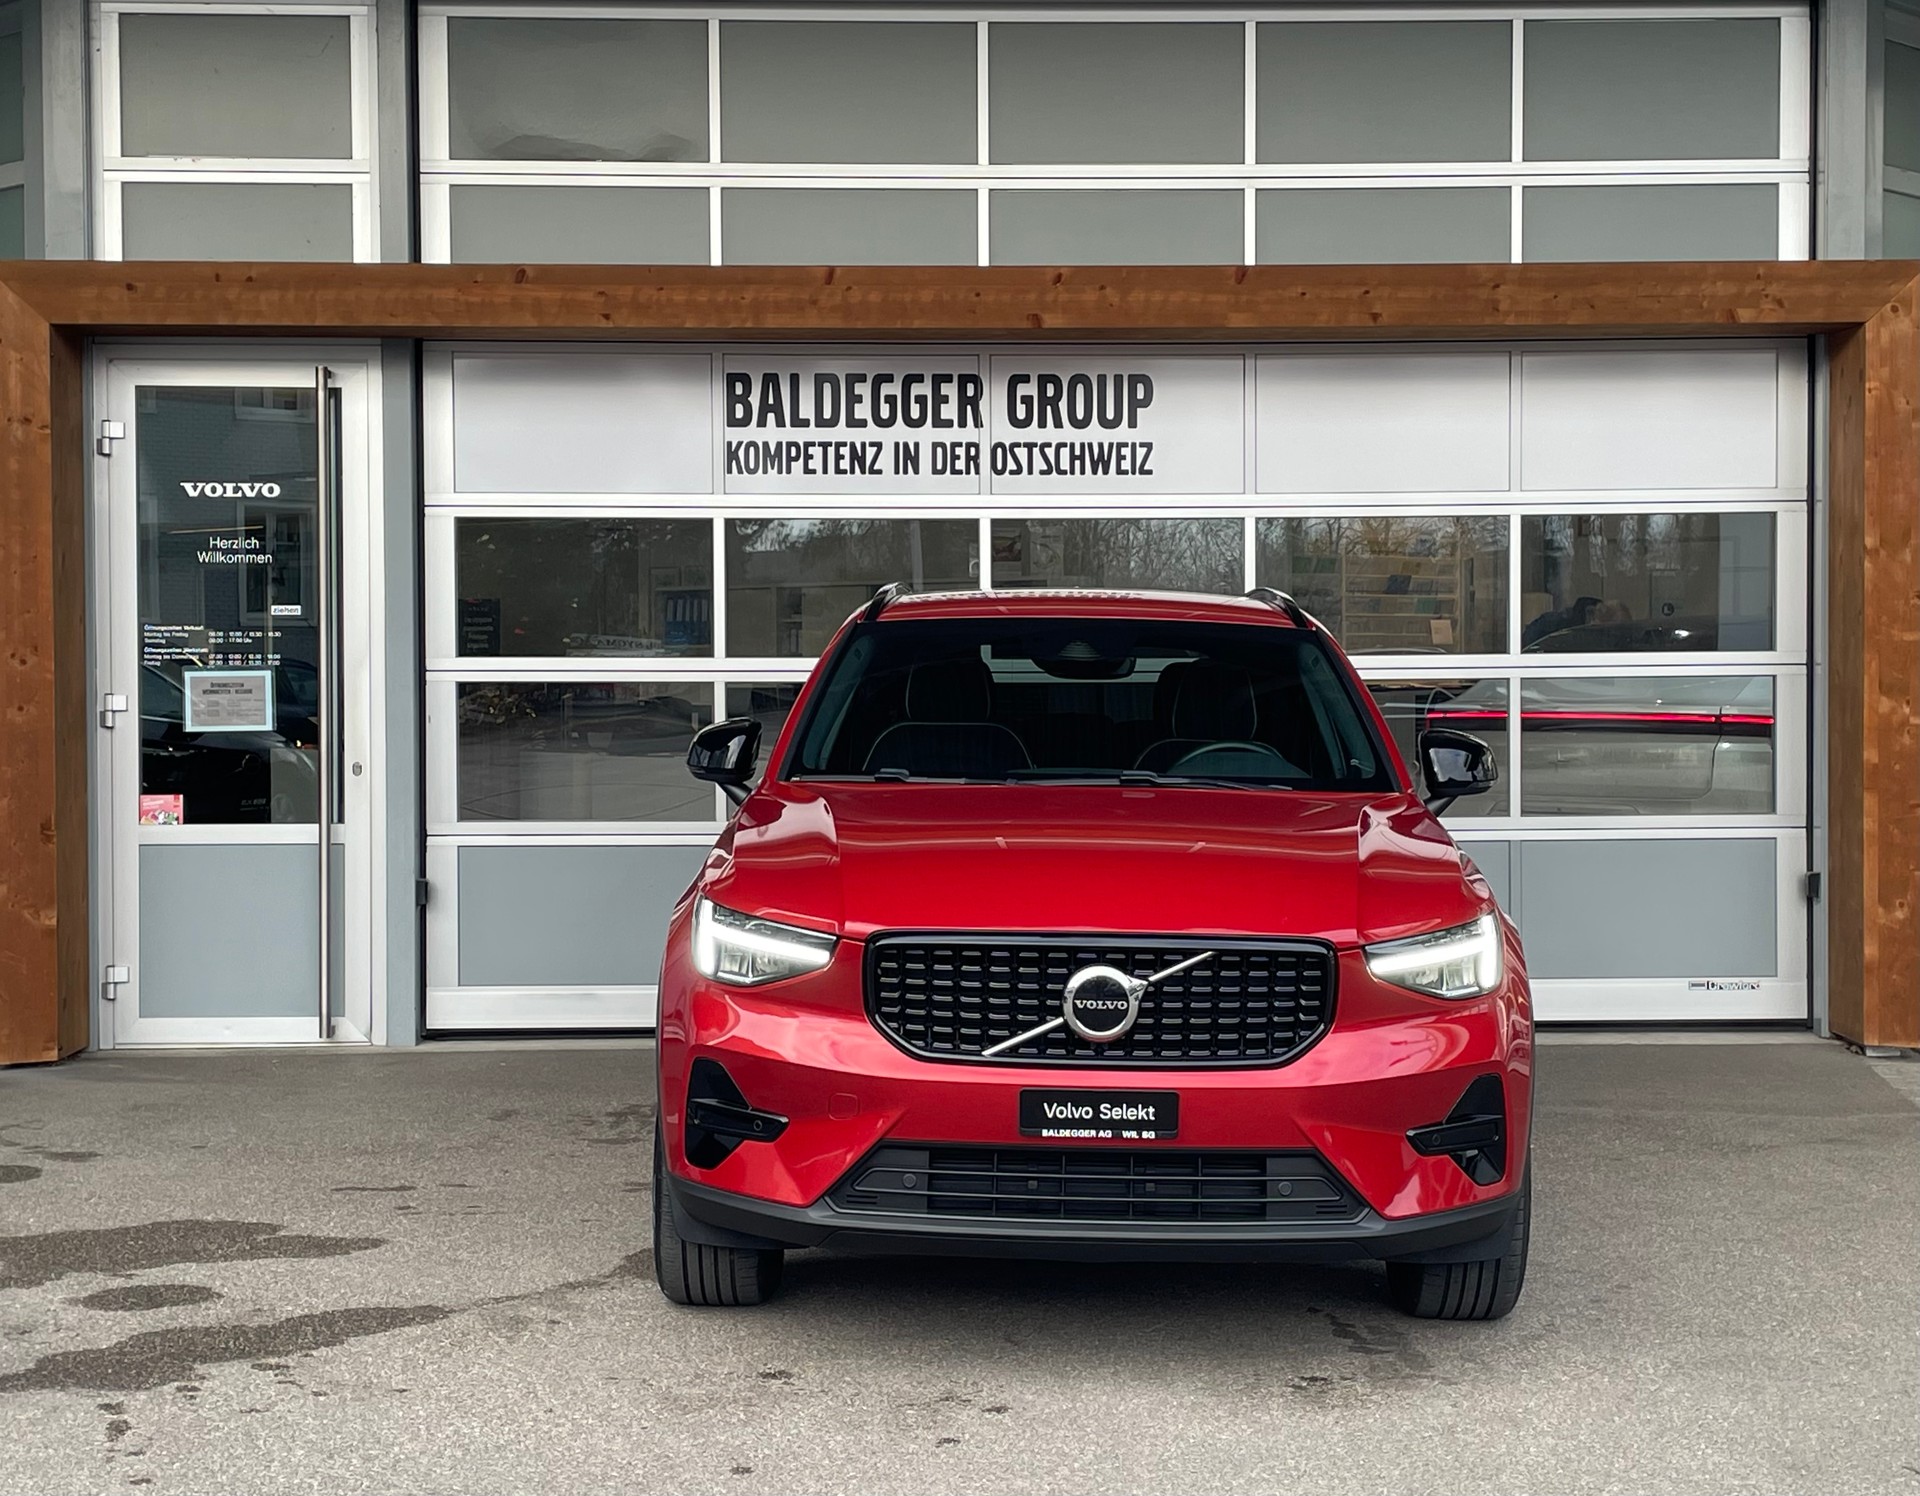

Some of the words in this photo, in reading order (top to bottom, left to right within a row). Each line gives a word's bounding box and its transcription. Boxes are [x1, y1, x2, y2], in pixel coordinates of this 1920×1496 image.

[726, 372, 984, 429] BALDEGGER
[1006, 373, 1155, 430] GROUP
[726, 440, 883, 476] KOMPETENZ
[894, 441, 921, 476] IN
[931, 441, 981, 476] DER
[991, 441, 1154, 476] OSTSCHWEIZ
[180, 482, 281, 498] VOLVO
[209, 536, 260, 550] Herzlich
[197, 550, 273, 565] Willkommen
[273, 606, 299, 614] ziehen
[1073, 999, 1128, 1010] VOLVO
[1043, 1102, 1093, 1120] Volvo
[1099, 1103, 1156, 1121] Selekt
[1041, 1128, 1096, 1138] BALDEGGER
[1098, 1129, 1113, 1138] AG
